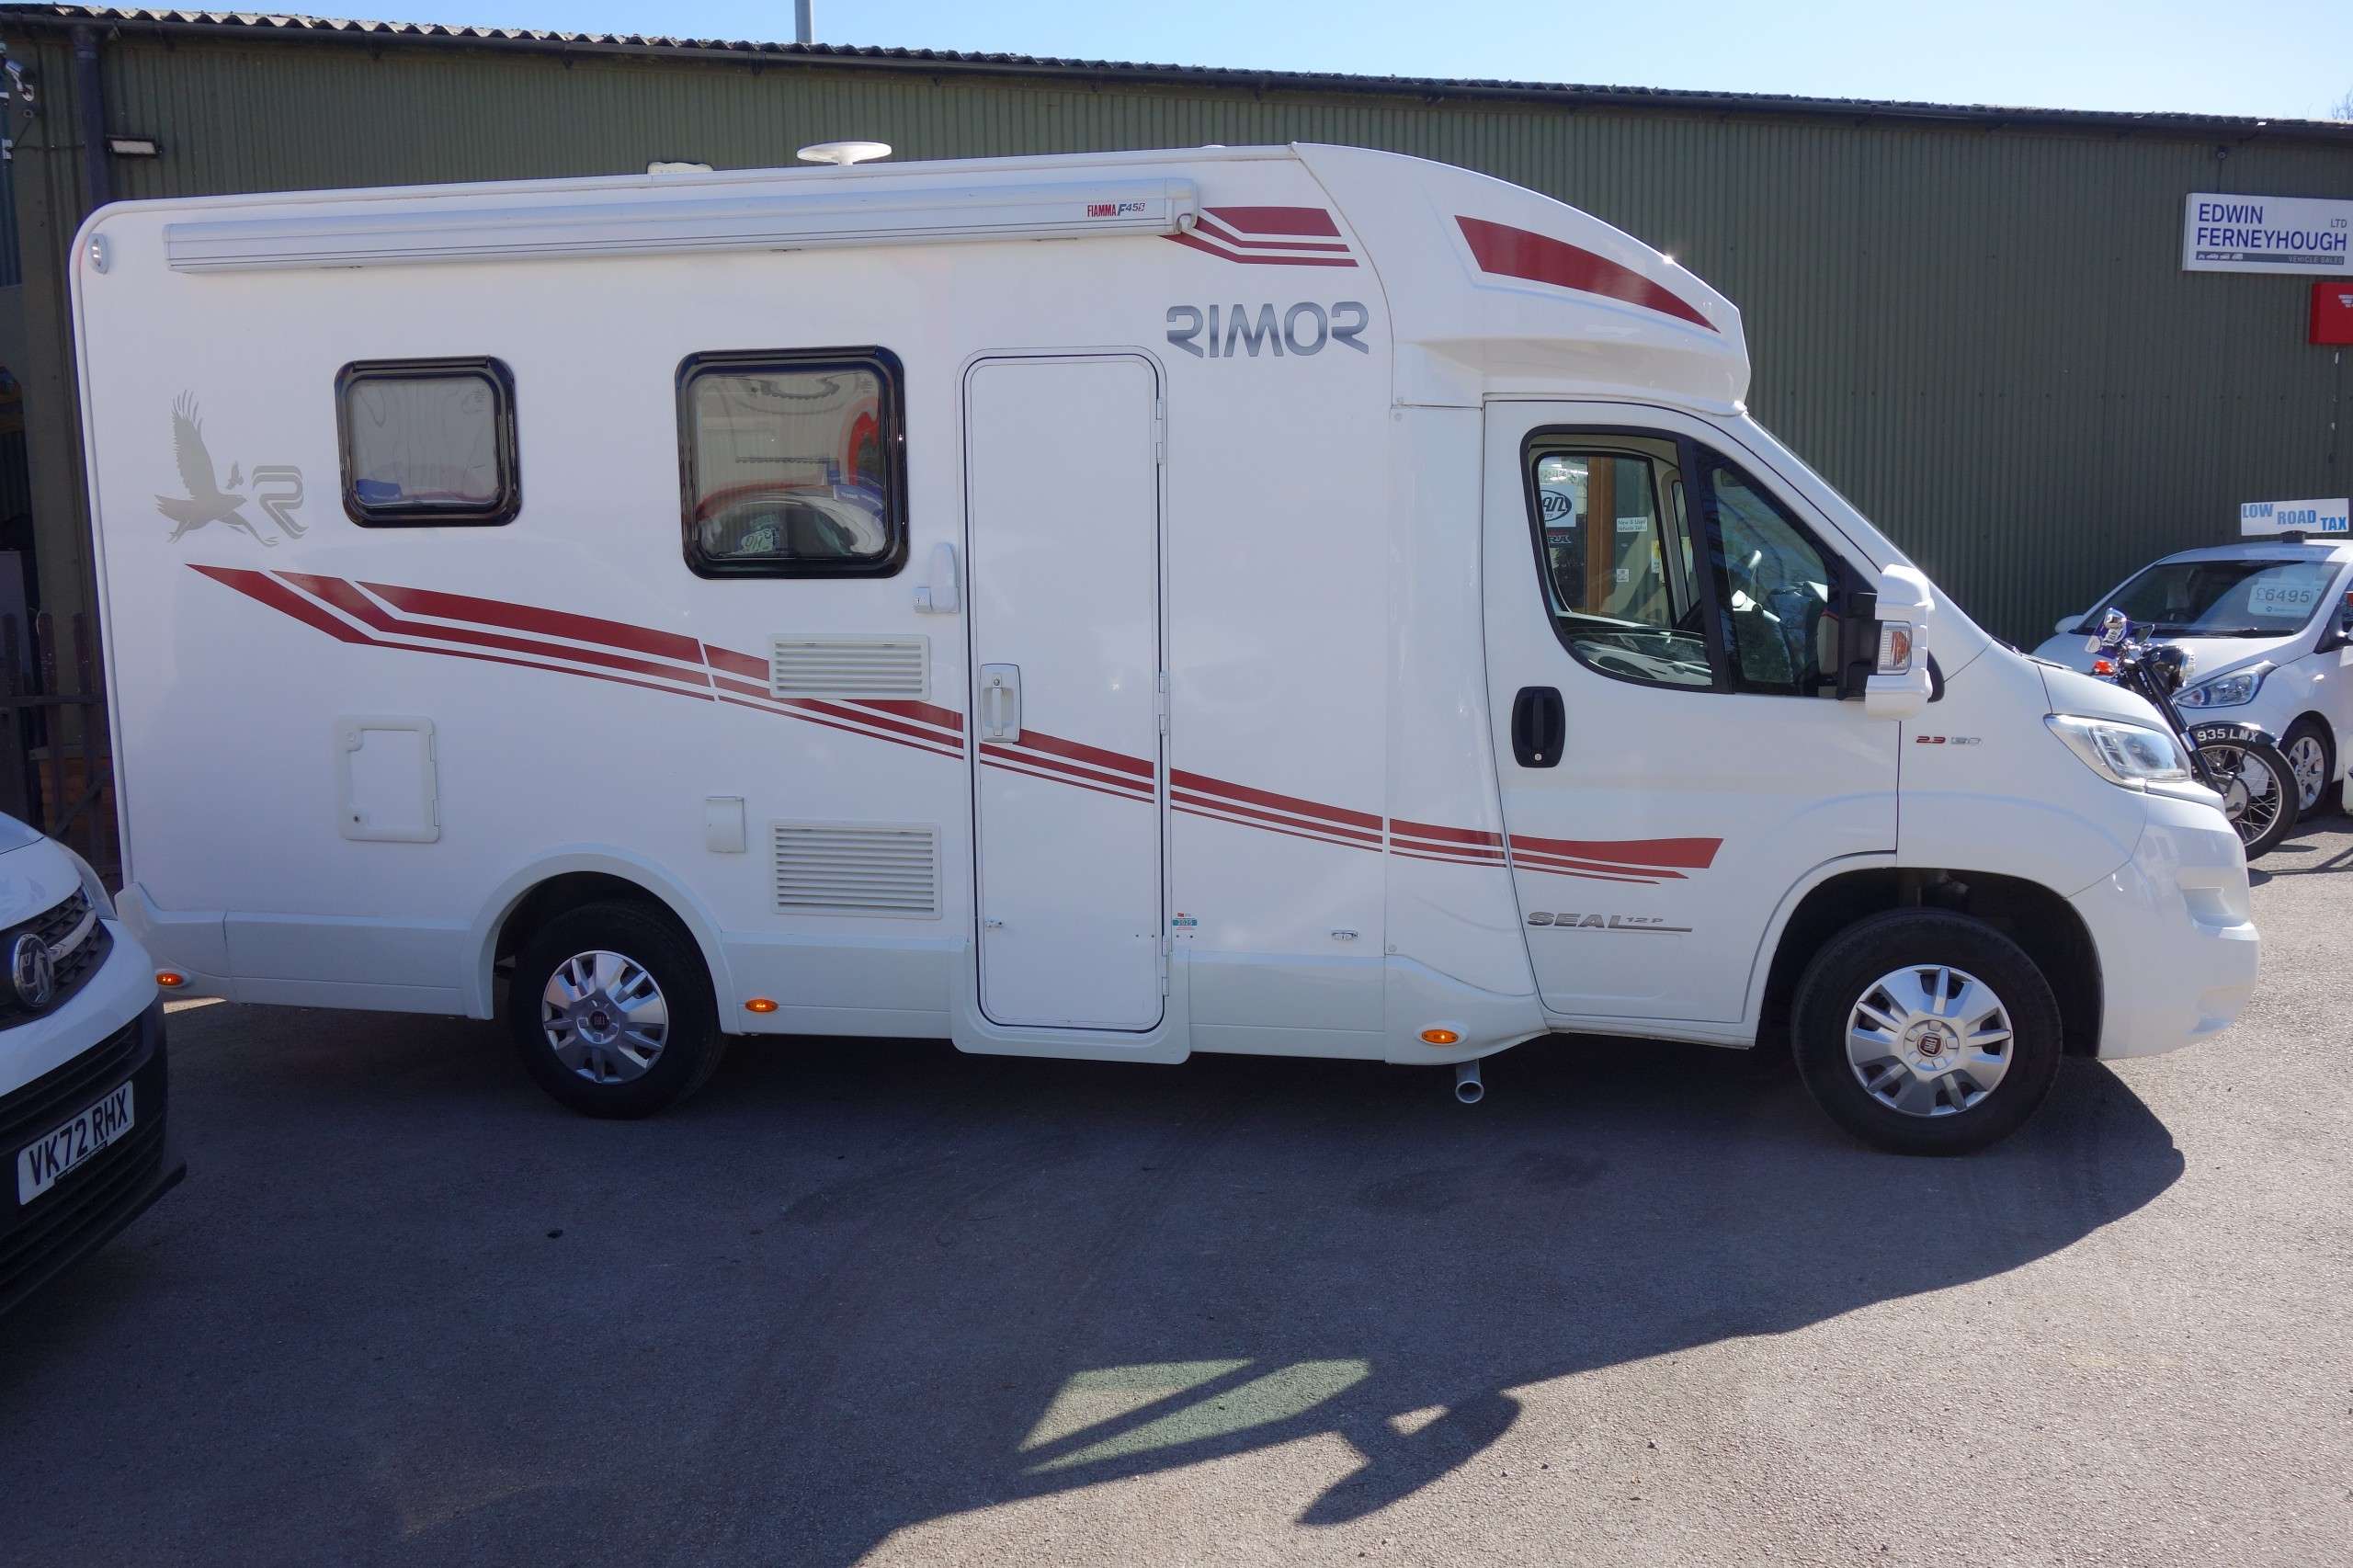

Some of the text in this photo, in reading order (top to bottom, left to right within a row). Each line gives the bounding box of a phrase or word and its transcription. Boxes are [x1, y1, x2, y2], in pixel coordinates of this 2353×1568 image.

[1087, 204, 1117, 218] FIAMMA
[2199, 203, 2264, 224] EDWIN
[2330, 219, 2347, 228] LTD
[2197, 226, 2347, 251] FERNEYHOUGH
[1166, 301, 1370, 358] RIMOR
[2242, 504, 2347, 530] LOW ROAD TAX
[2198, 728, 2258, 743] 935 LMX
[1528, 911, 1621, 929] SEAL
[28, 1118, 88, 1187] VK72
[92, 1088, 128, 1147] RHX
